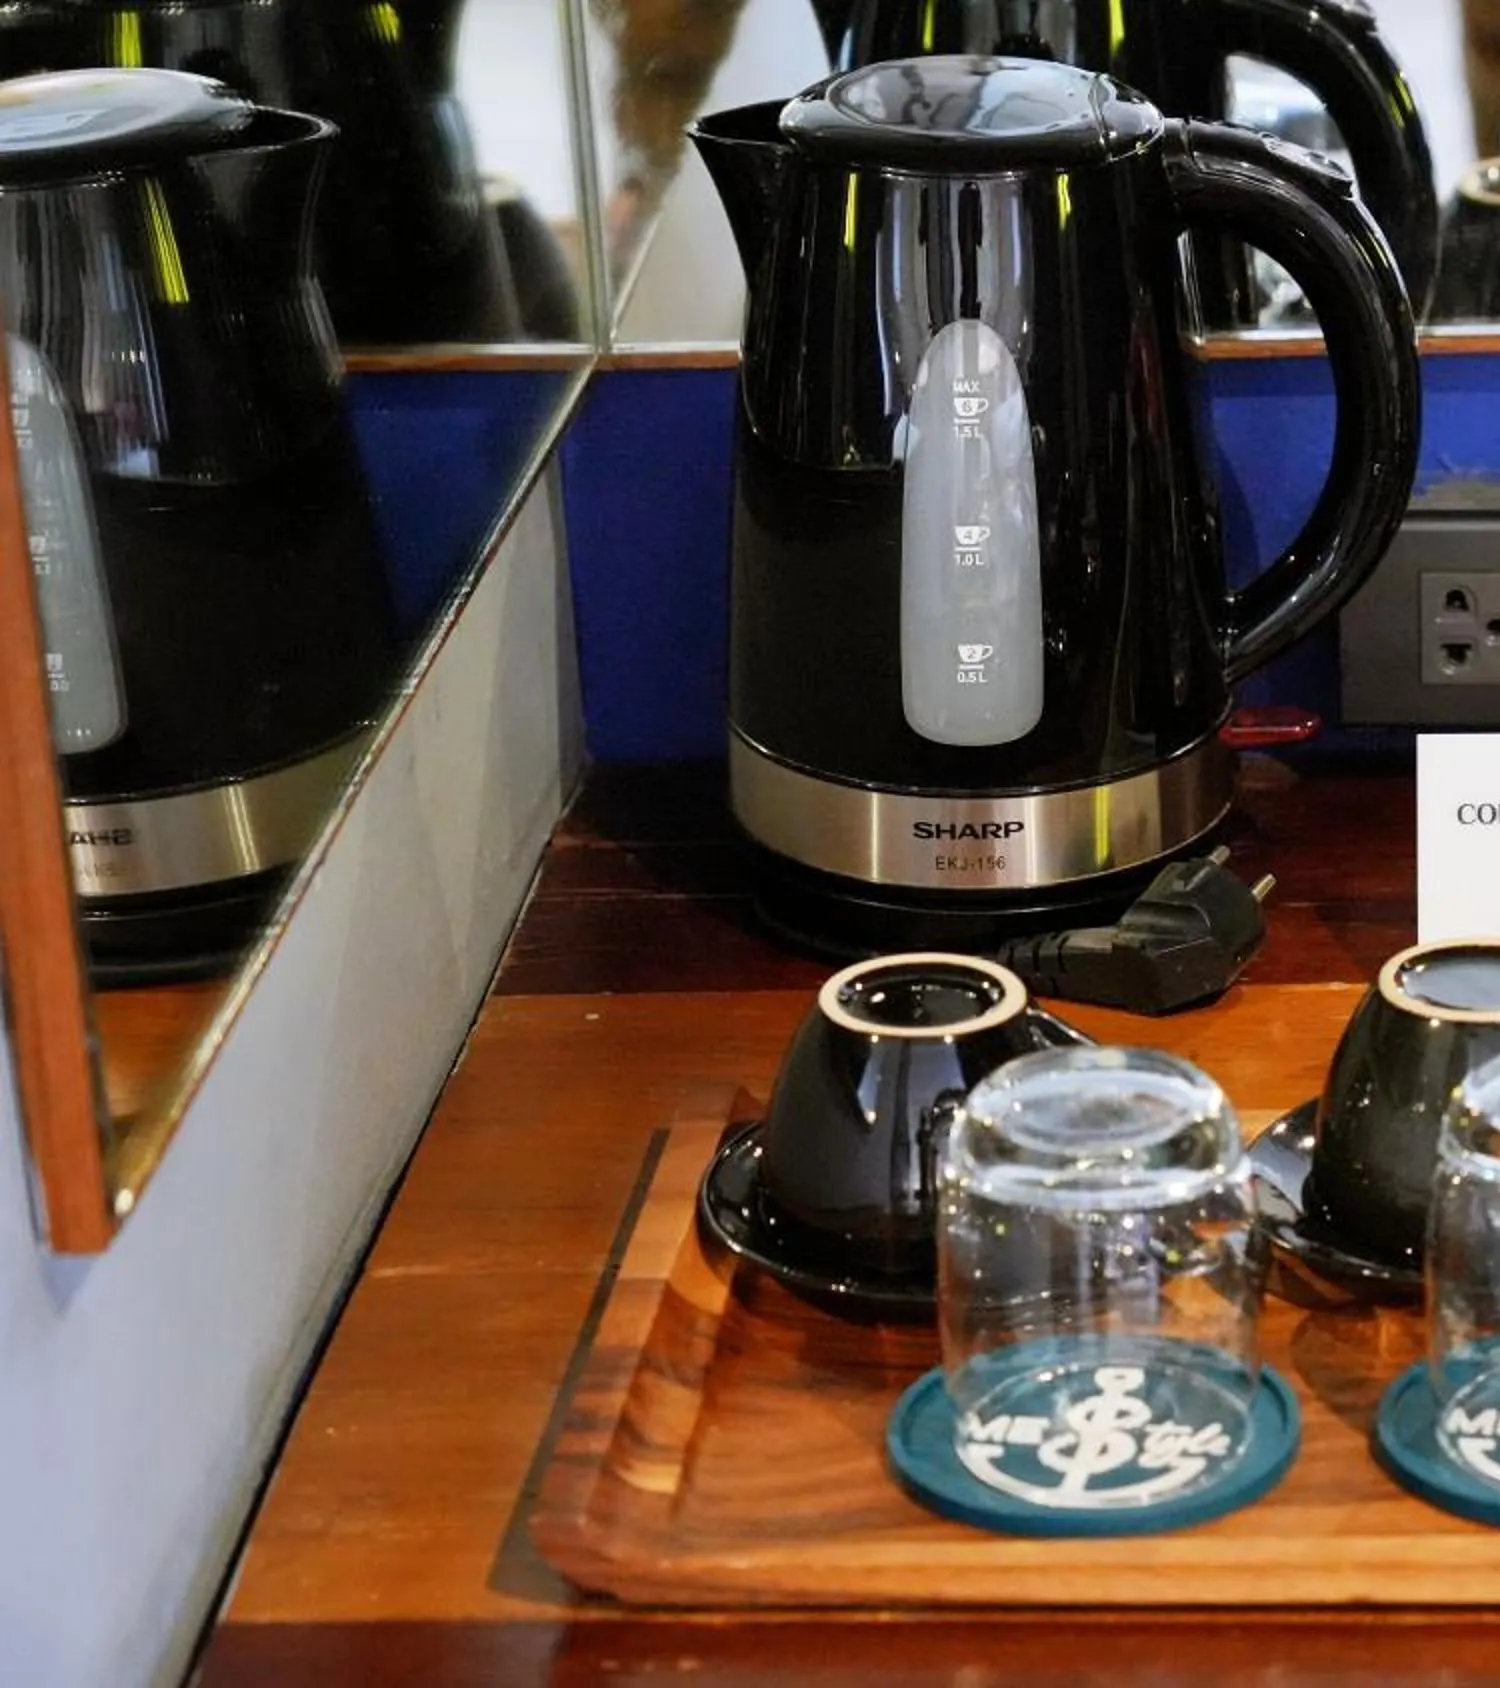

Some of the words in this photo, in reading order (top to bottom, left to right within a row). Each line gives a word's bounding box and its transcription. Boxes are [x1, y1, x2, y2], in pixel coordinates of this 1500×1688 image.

[953, 379, 980, 393] MAX
[912, 821, 1025, 840] SHARP
[935, 856, 1007, 871] EKJ-156
[962, 1411, 1051, 1446] ME
